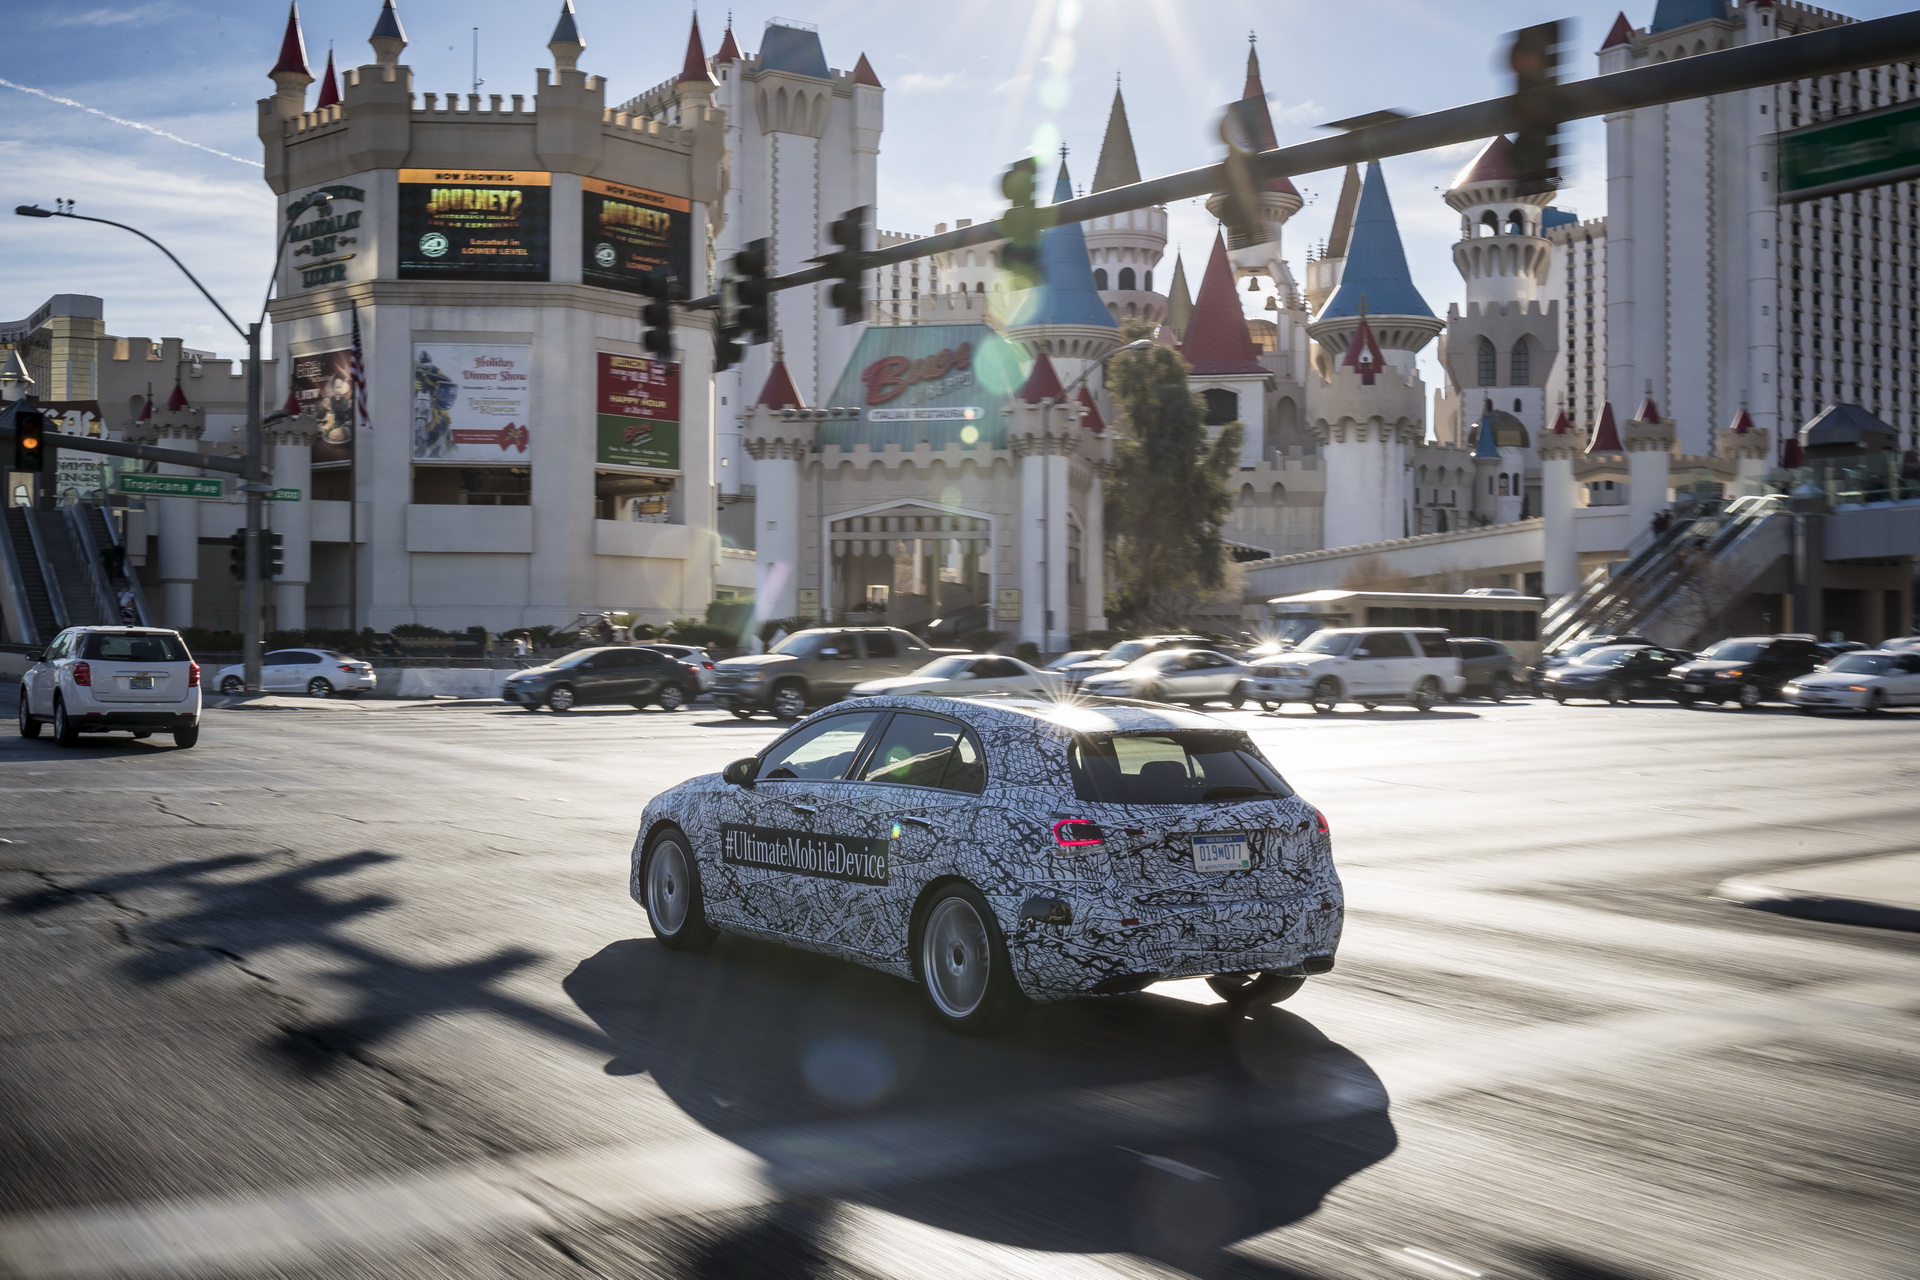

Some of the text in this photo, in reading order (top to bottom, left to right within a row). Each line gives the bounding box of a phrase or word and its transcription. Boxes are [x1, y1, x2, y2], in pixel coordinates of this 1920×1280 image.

[463, 173, 515, 182] SHOWING
[289, 210, 362, 243] MANDALAY
[311, 235, 338, 256] BAY
[469, 238, 520, 246] Located in
[499, 248, 529, 256] LEVEL
[473, 355, 515, 369] Holiday
[462, 369, 528, 381] Dinner Show
[609, 395, 668, 408] HAPPY HOUR
[913, 408, 980, 419] RESTAURAT
[123, 478, 218, 493] Tropicana Ave
[725, 829, 886, 880] #UltimateMobileDevice
[1199, 844, 1242, 861] 019M077
